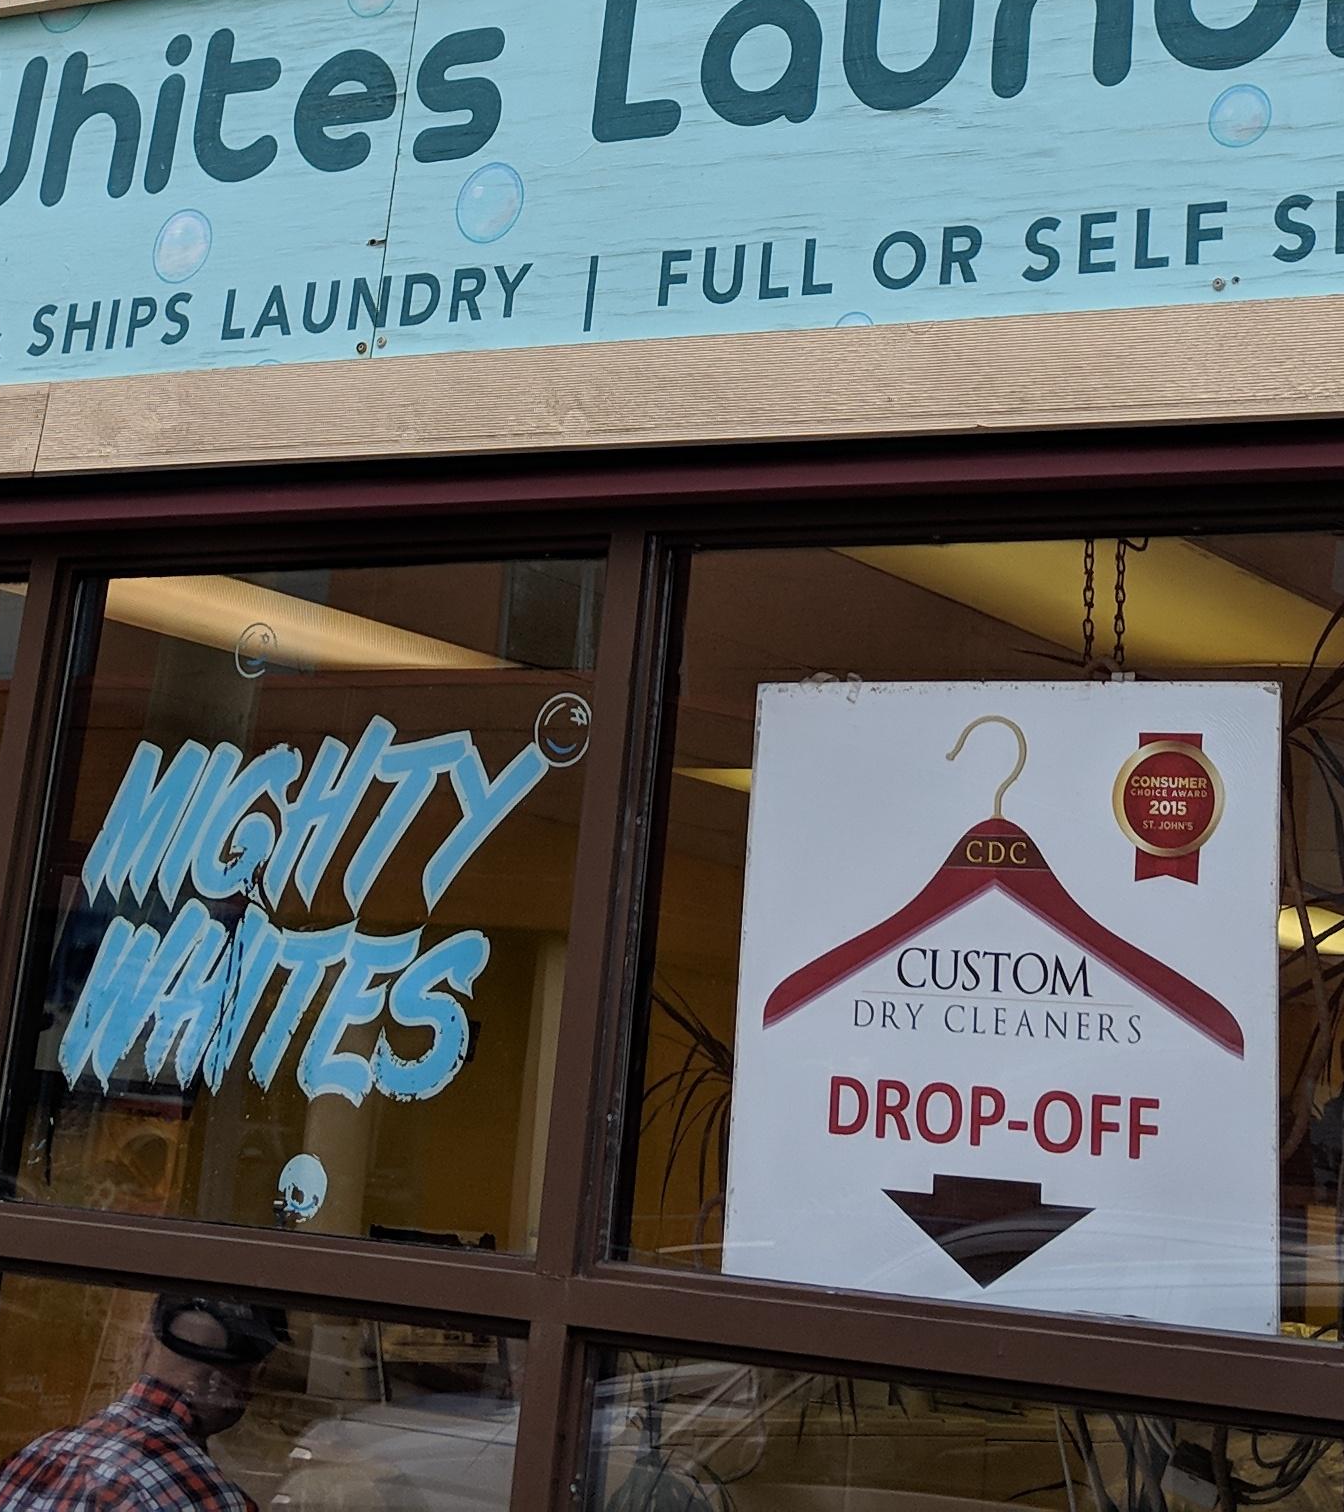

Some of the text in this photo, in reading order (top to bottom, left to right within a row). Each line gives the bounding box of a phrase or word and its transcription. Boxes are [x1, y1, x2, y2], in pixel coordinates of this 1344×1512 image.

[27, 291, 193, 357] SHIPS
[220, 263, 534, 341] LAUNDRY
[657, 238, 834, 307] FULL
[873, 225, 983, 289] OR
[1022, 201, 1229, 283] SELF
[1130, 776, 1208, 789] CONSUMER
[1130, 788, 1208, 798] CHOICE AWARD
[81, 713, 551, 918] MIGHTY
[1149, 800, 1187, 816] 2015
[1158, 821, 1193, 831] JOHN'S
[966, 840, 1027, 864] CDC
[896, 947, 1094, 999] CUSTOM
[57, 897, 492, 1110] WHITES
[853, 999, 1142, 1046] DRY CLEANERS
[827, 1075, 1161, 1160] DROP-OFF
